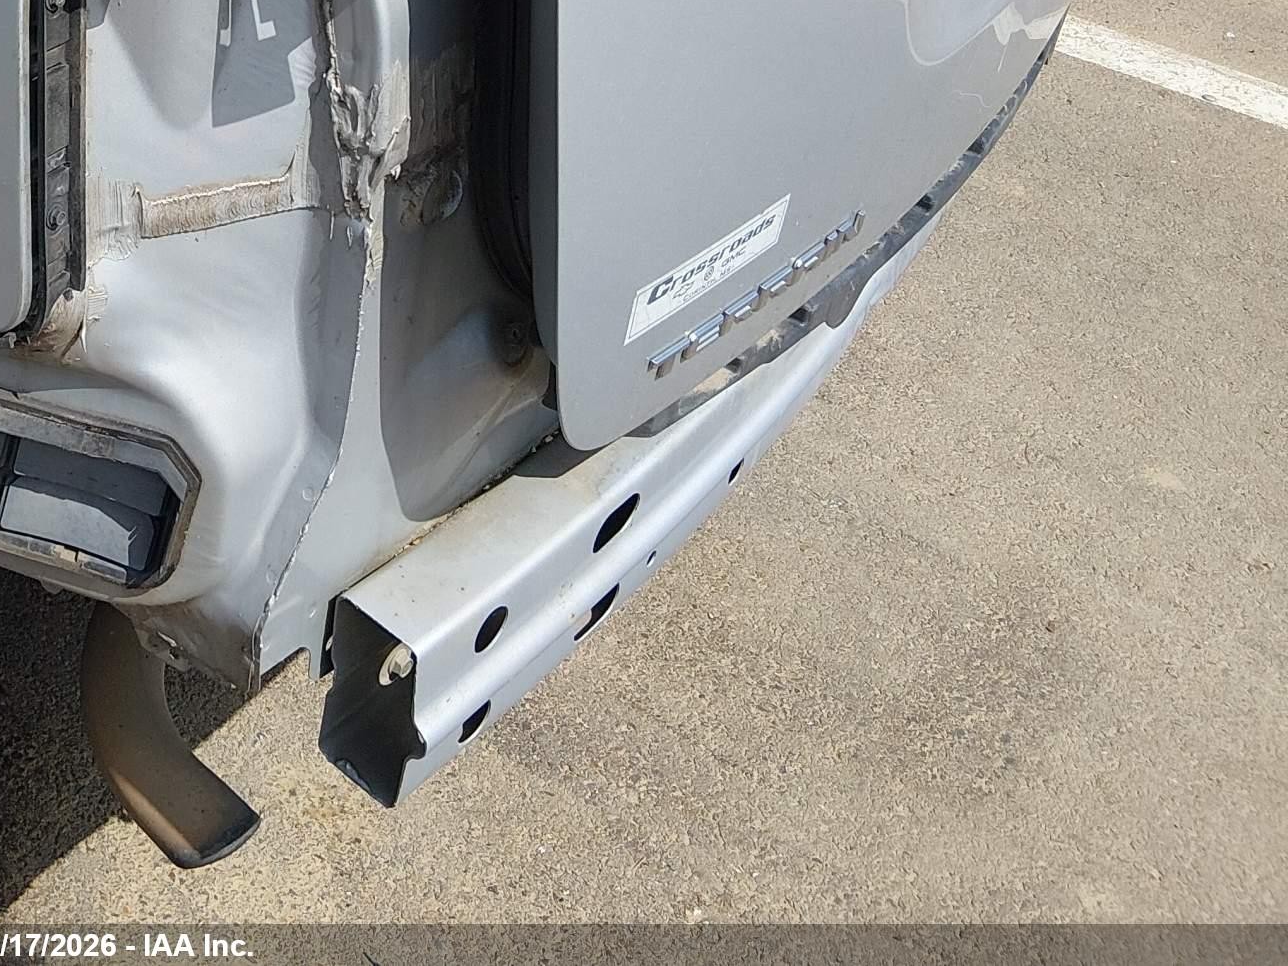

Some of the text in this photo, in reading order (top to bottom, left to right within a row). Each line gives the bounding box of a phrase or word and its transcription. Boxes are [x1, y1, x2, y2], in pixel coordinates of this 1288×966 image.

[646, 214, 777, 306] Crossroads
[646, 209, 867, 381] TERRAIN
[720, 245, 748, 268] GMC
